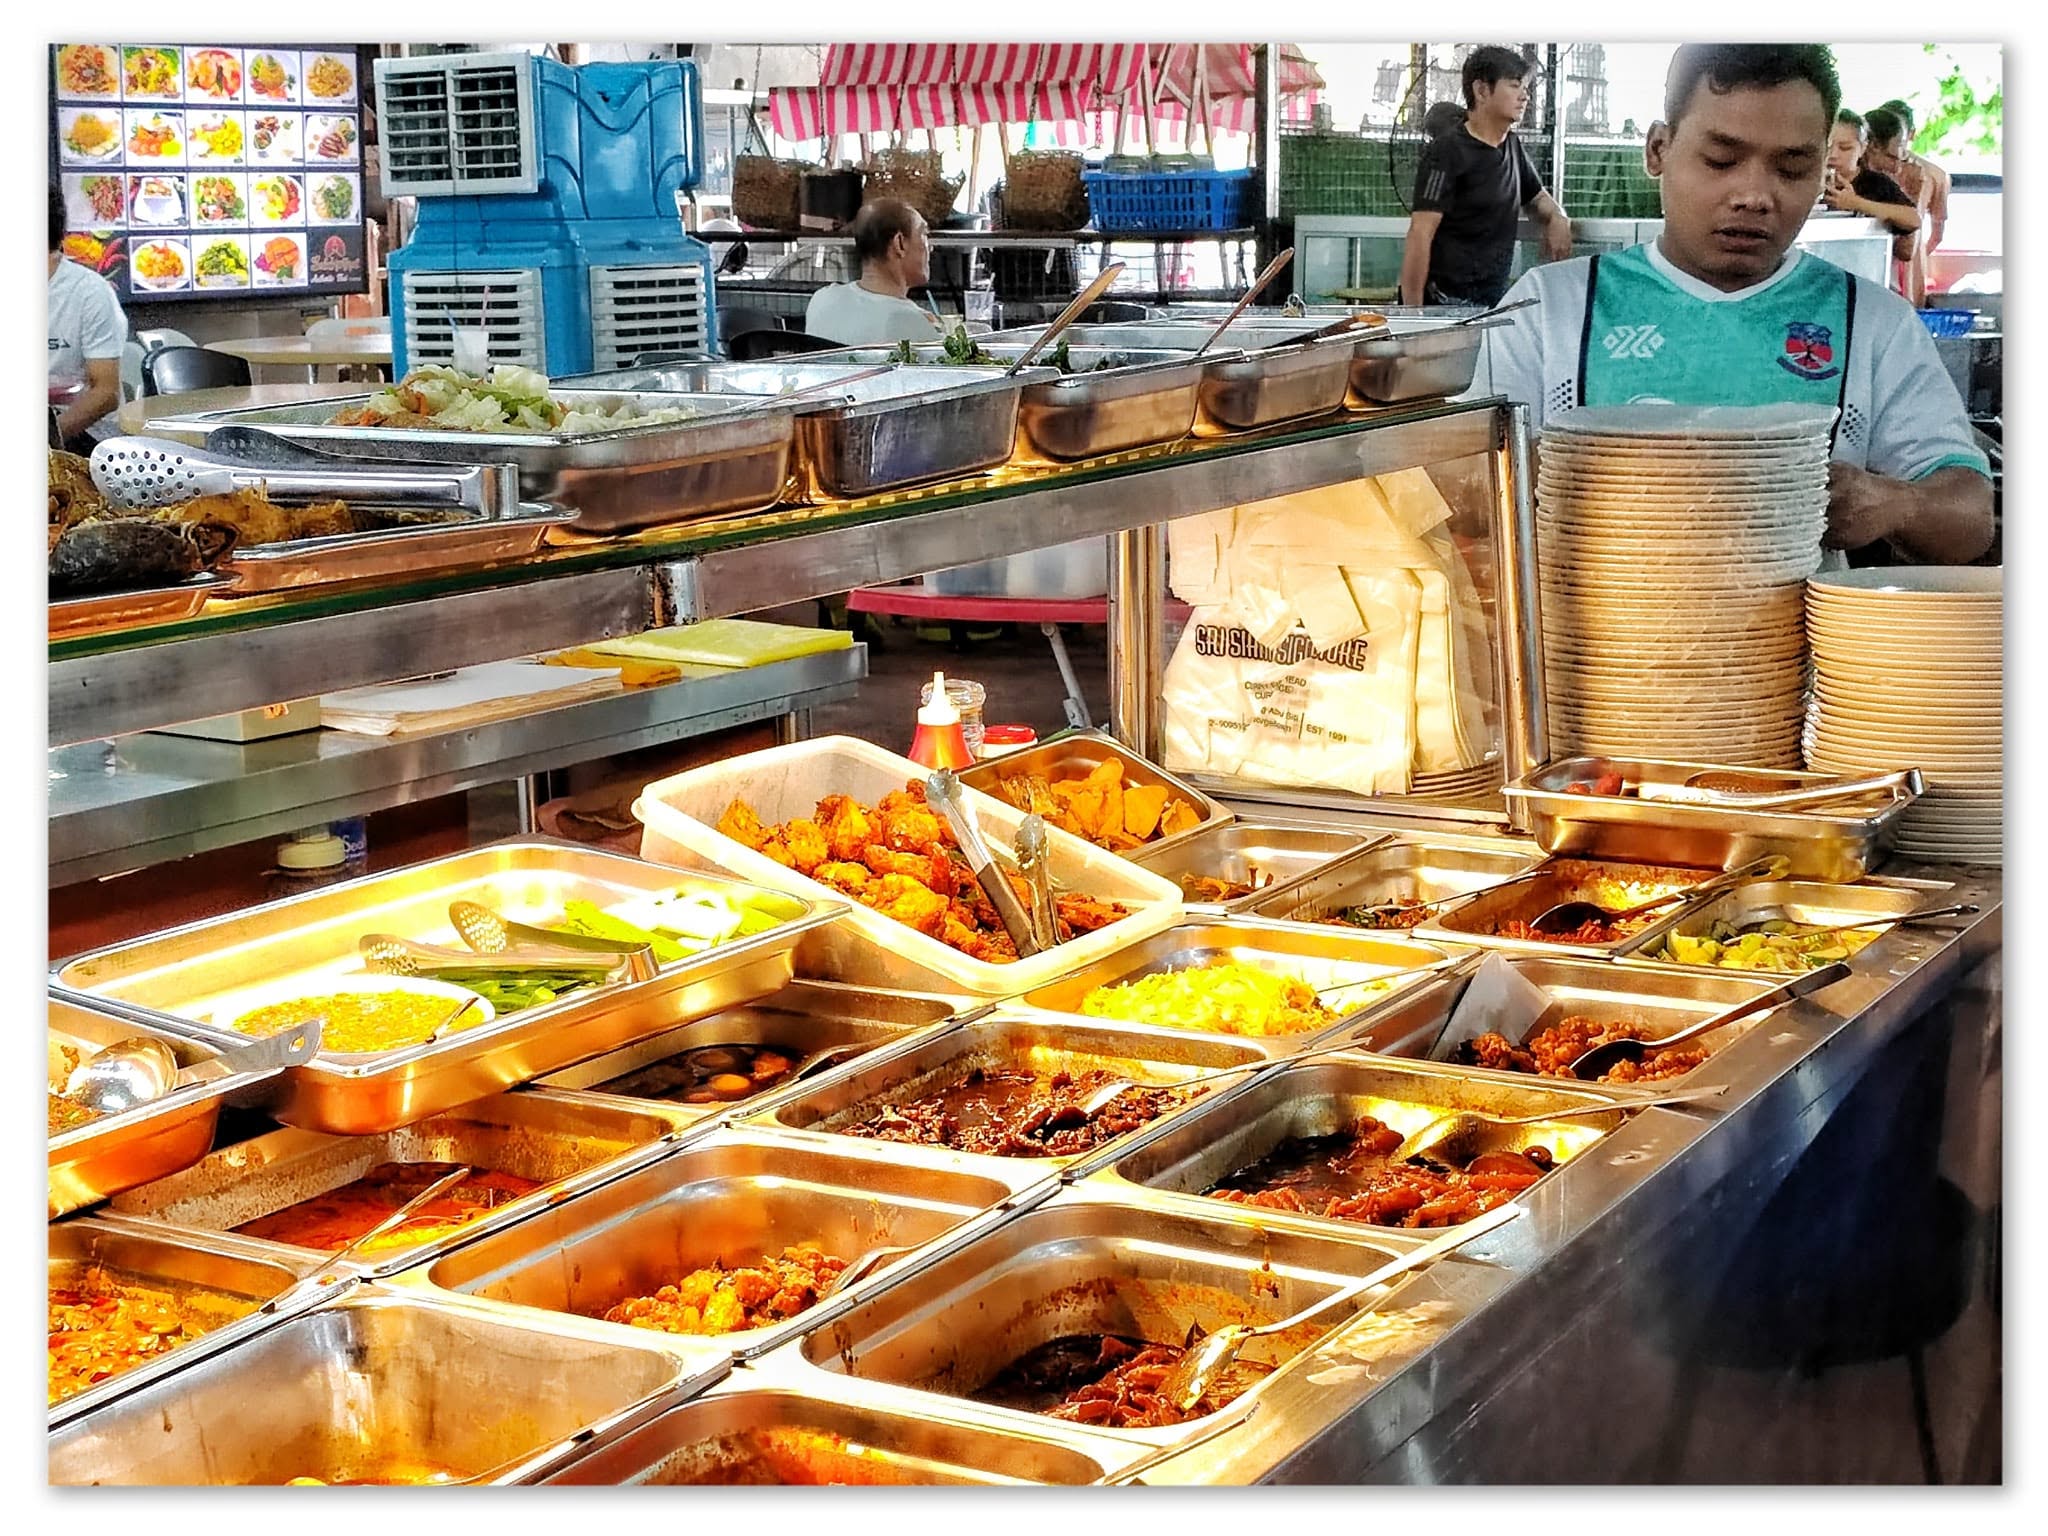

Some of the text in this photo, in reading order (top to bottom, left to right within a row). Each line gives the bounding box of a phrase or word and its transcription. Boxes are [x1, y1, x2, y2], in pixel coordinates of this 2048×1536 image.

[1195, 625, 1228, 656] SRI
[1276, 633, 1368, 671] SIGNURE
[1306, 723, 1324, 735] EST
